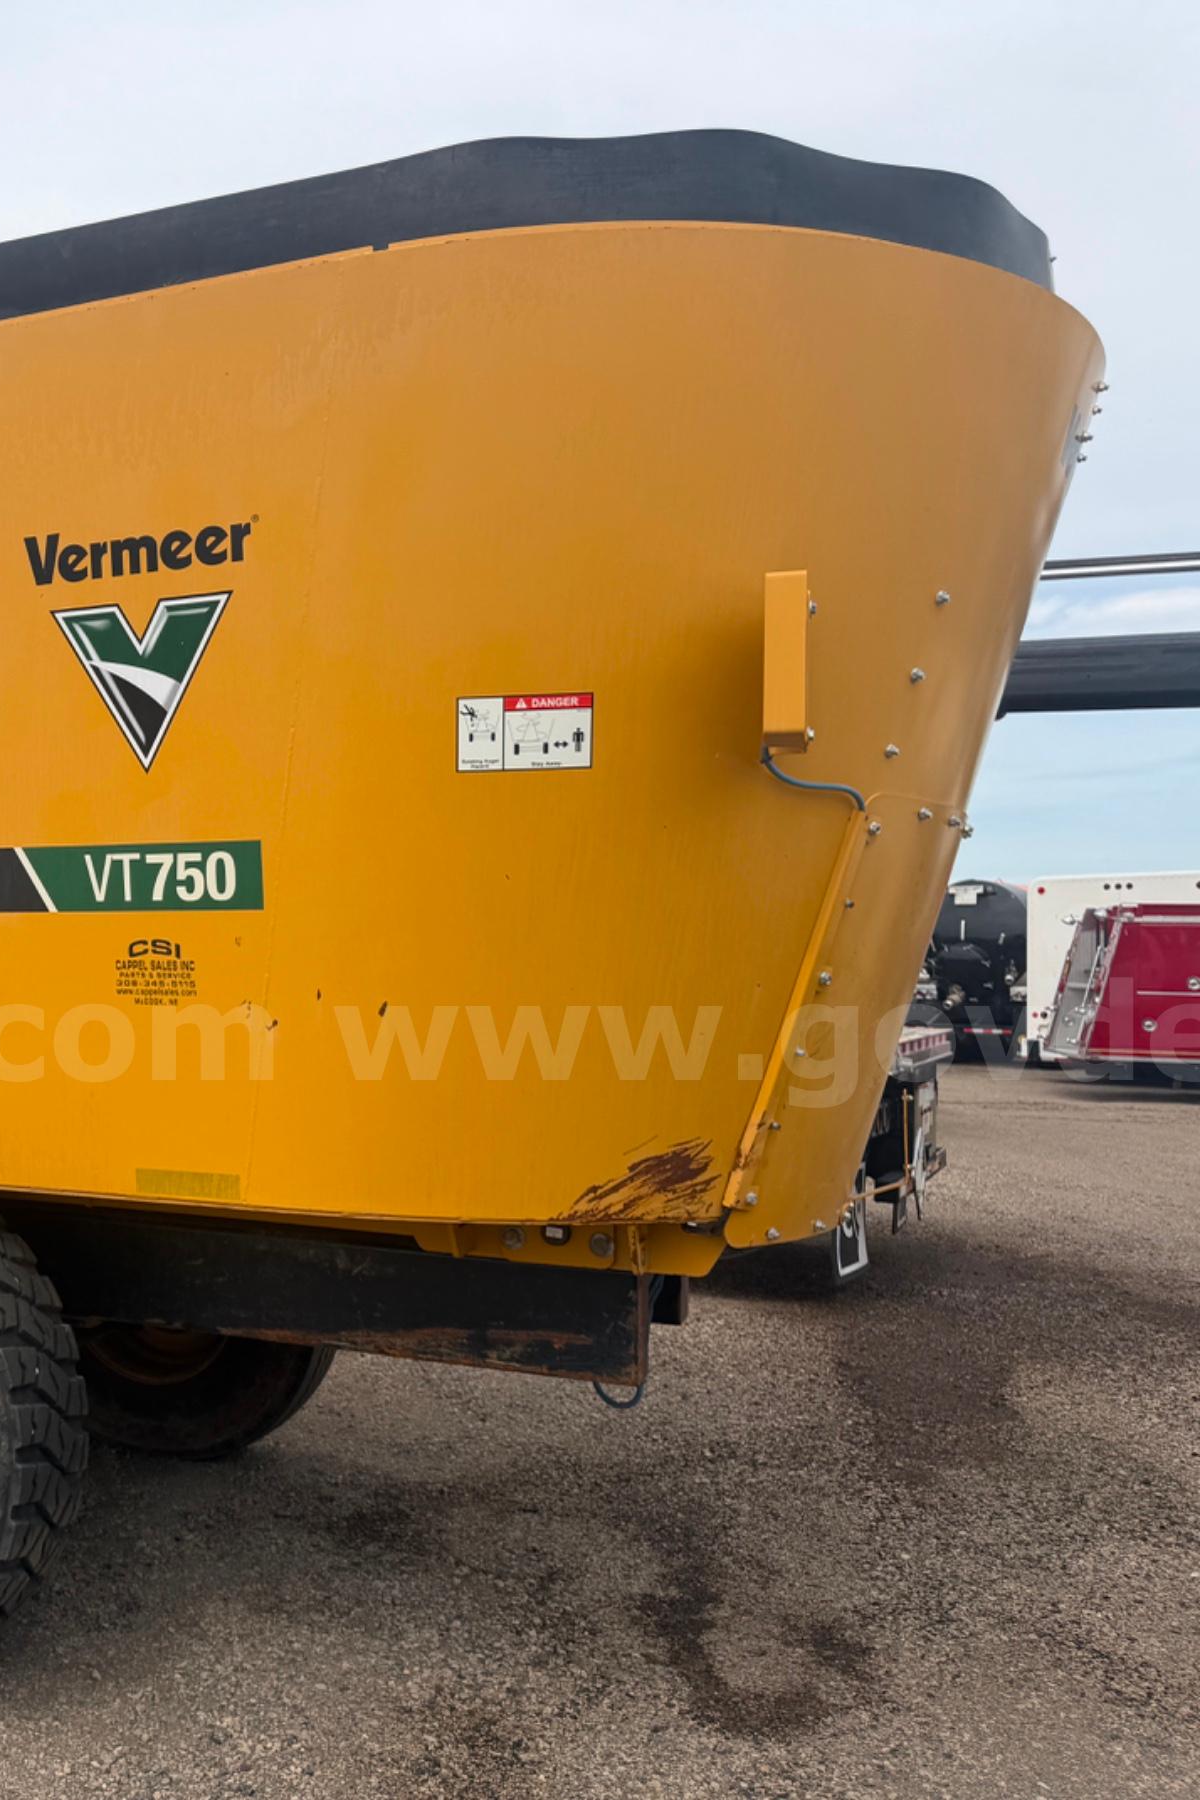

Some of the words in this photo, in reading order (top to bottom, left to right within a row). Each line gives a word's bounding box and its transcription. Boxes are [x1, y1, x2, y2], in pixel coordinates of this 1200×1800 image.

[23, 522, 252, 586] Vermeer
[531, 696, 580, 708] DANGER
[128, 938, 181, 960] CSI
[115, 960, 148, 971] CAPPEL
[150, 960, 178, 971] SALES
[180, 960, 196, 972] INC
[156, 972, 192, 980] SERVICE
